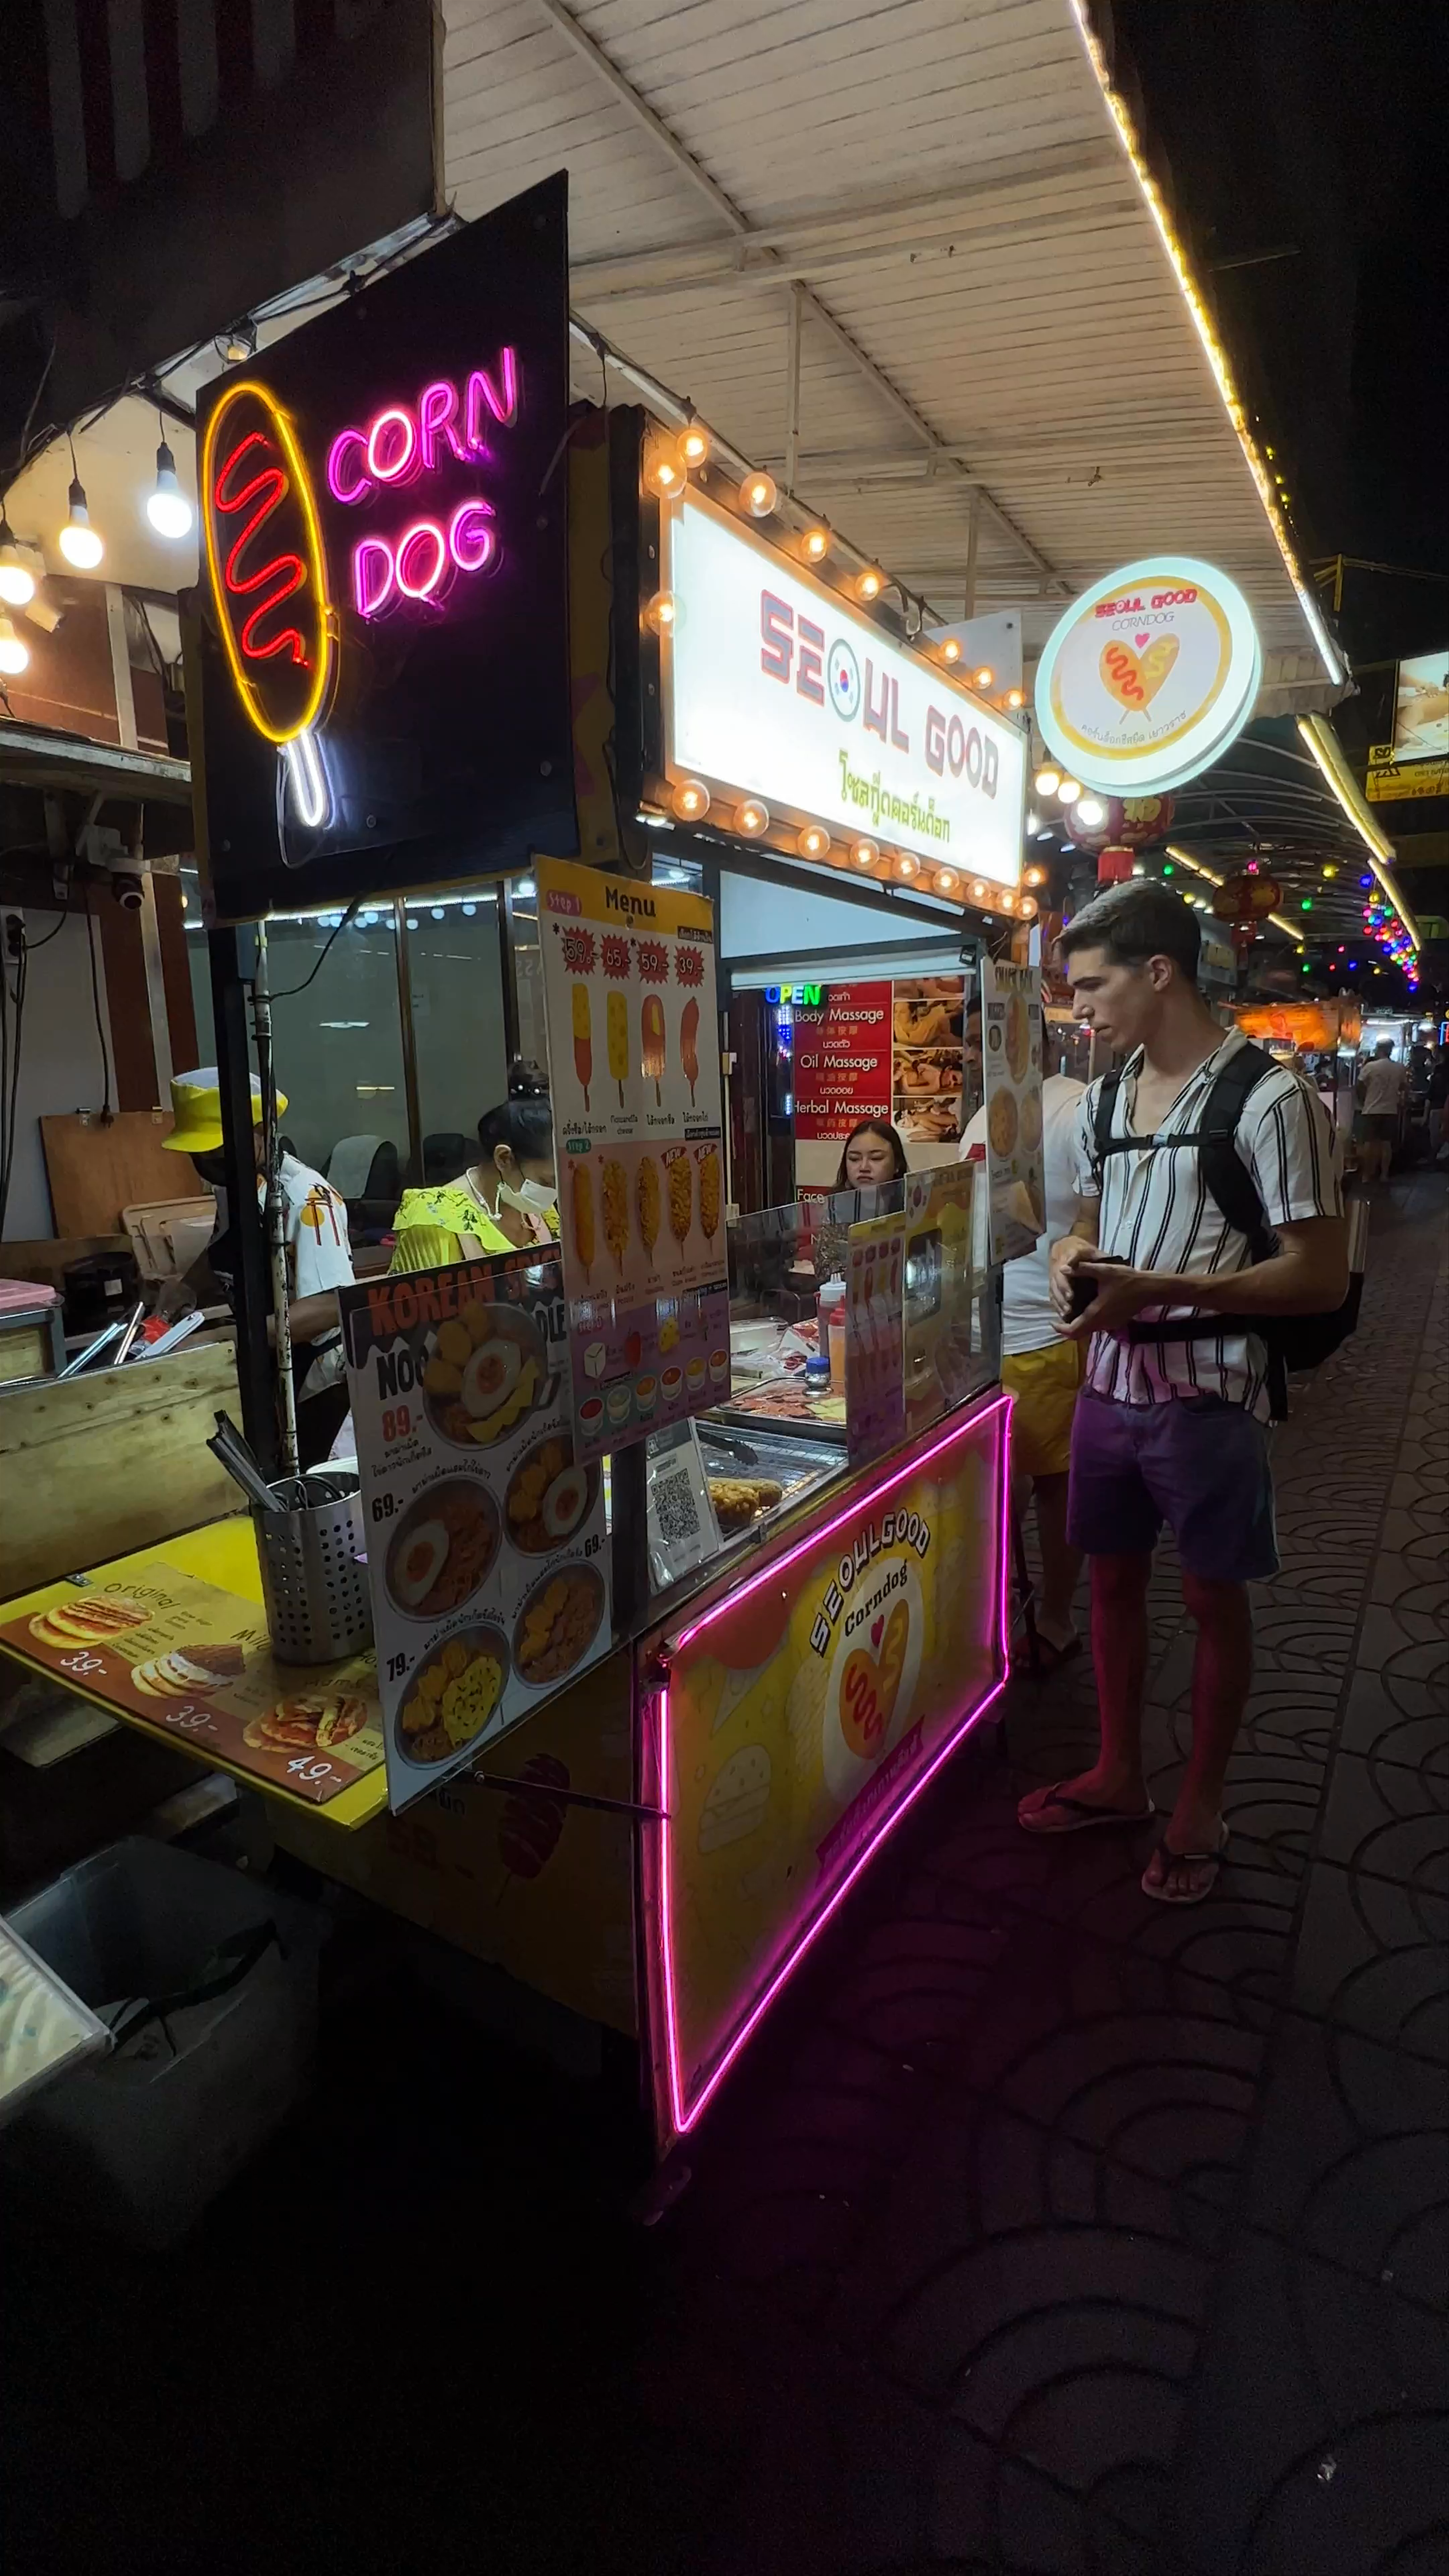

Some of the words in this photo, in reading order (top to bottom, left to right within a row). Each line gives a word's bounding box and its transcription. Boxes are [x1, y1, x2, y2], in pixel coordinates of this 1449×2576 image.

[328, 346, 518, 504] CORN
[354, 500, 498, 623] DOG
[1095, 598, 1146, 618] SEOUL
[1151, 589, 1197, 610] GOOD
[1112, 611, 1174, 631] CORNDOG
[760, 589, 909, 754] SEOUL
[924, 704, 999, 800] GOOD
[549, 893, 572, 913] Step
[605, 886, 656, 918] Menu
[765, 984, 821, 1005] OPEN
[795, 1010, 824, 1026] Body
[830, 1008, 884, 1024] Massage
[800, 1055, 819, 1069] Oil
[823, 1055, 878, 1071] Massage
[834, 1101, 889, 1118] Massage
[666, 1147, 681, 1167] NEW
[698, 1144, 712, 1163] NEW
[797, 1189, 825, 1204] Face
[368, 1263, 495, 1336] KOREAN
[382, 1404, 423, 1442] 89.-
[372, 1493, 404, 1522] 69.-
[584, 1534, 606, 1557] 69.-
[104, 1583, 181, 1609] Original
[844, 1559, 908, 1637] Corndog
[60, 1651, 107, 1676] 39.-
[386, 1652, 415, 1681] 79.-
[166, 1705, 218, 1732] 39.-
[287, 1755, 341, 1786] 49.-
